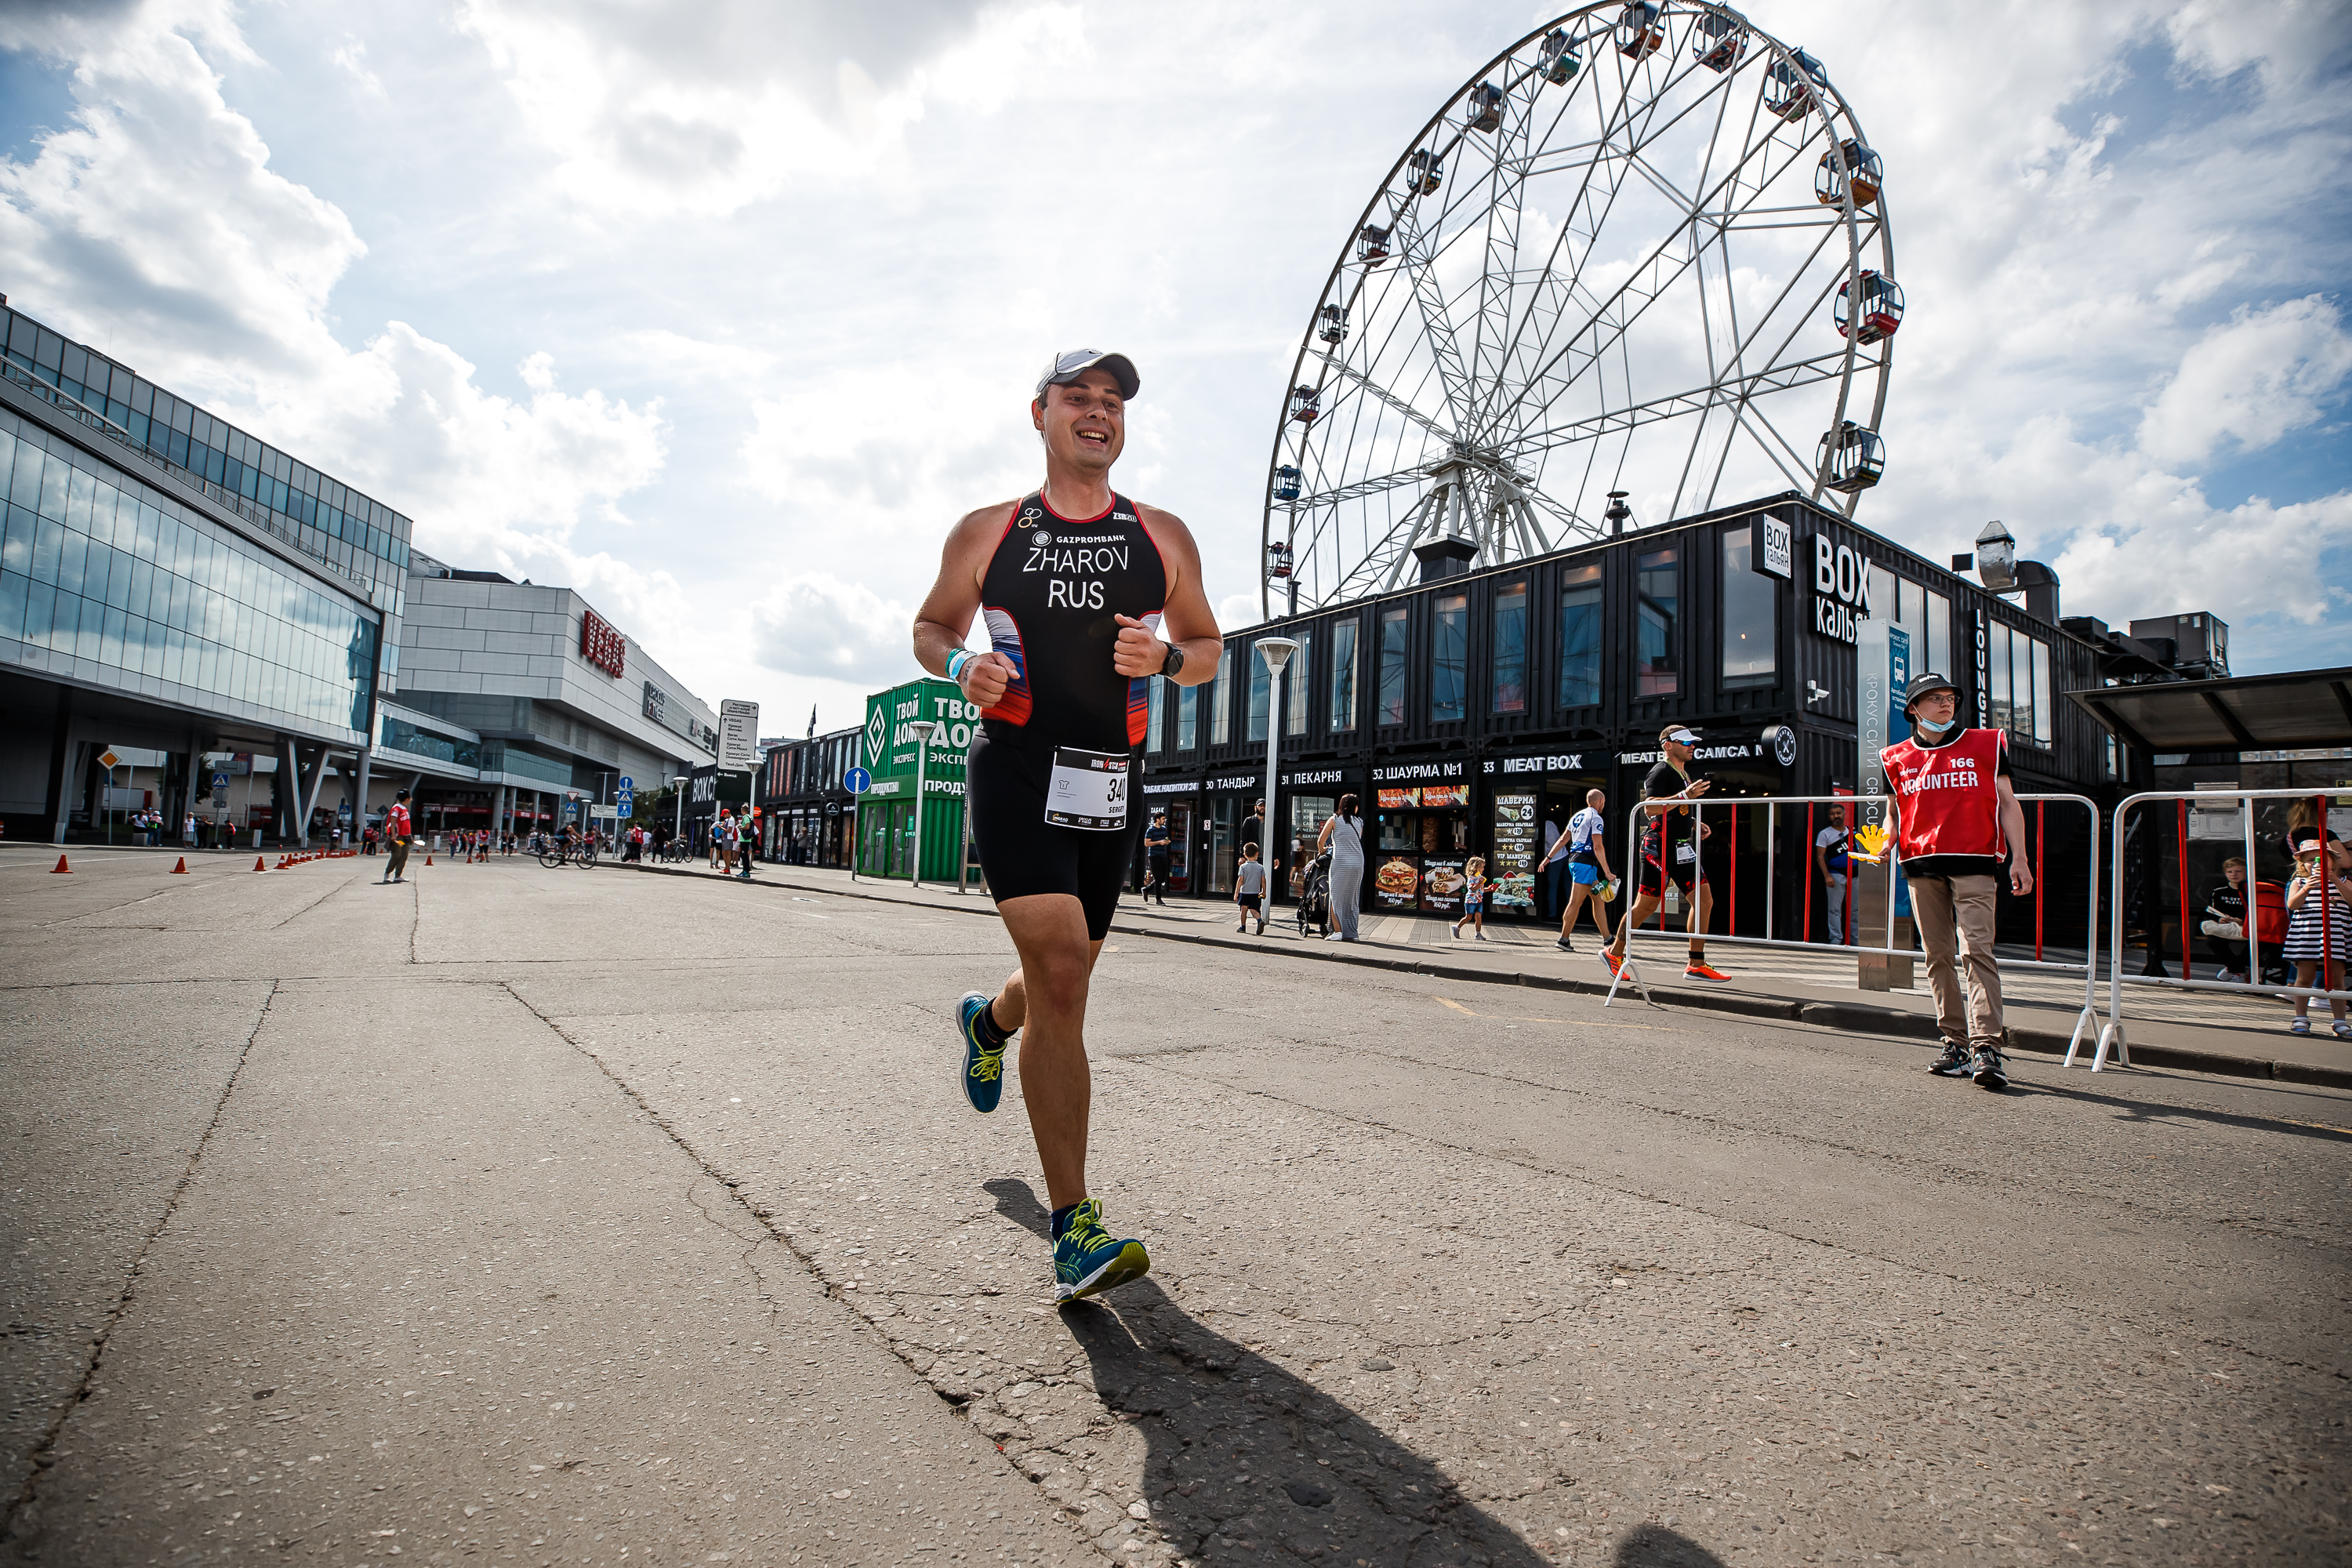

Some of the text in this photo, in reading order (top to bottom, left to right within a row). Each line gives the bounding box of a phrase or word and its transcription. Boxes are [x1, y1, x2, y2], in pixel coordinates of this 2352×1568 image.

[1056, 535, 1126, 544] GAZPROMBANK
[1766, 524, 1788, 554] BOX
[1022, 546, 1128, 574] ZHAROV
[1817, 532, 1871, 612] BOX
[1047, 579, 1105, 610] RUS
[583, 610, 626, 679] VEGAS
[1976, 608, 1987, 730] LOUNGE
[896, 693, 919, 720] ТВОЙ
[934, 697, 980, 721] ТВО
[1866, 673, 1878, 768] КРОКУС СИТИ
[893, 720, 917, 748] ДОМ
[928, 720, 978, 749] ДО
[892, 753, 916, 765] ЭКСПРЕСС
[929, 752, 967, 765] ЭКСП
[1621, 751, 1657, 764] MEAT
[1693, 745, 1750, 760] САМСА
[1091, 759, 1104, 768] IRON
[1483, 754, 1582, 773] 33 MEAT BOX
[1950, 757, 1975, 768] 166
[1281, 771, 1341, 785] 31 ПЕКАРНЯ
[1373, 763, 1462, 780] 32 ШАУРМА №1
[692, 776, 708, 802] BOX
[870, 781, 899, 796] ПРОДУКТЫ
[924, 780, 966, 796] ПРОДУ
[1107, 777, 1126, 803] 340
[1160, 783, 1188, 793] НАПИТКИ
[1206, 776, 1255, 789] 30 ТАНДЫР
[1900, 771, 1979, 796] VOLUNTEER
[1497, 796, 1534, 805] ШАВЕРМА
[1108, 805, 1124, 814] SERGEY
[1522, 808, 1533, 817] 24
